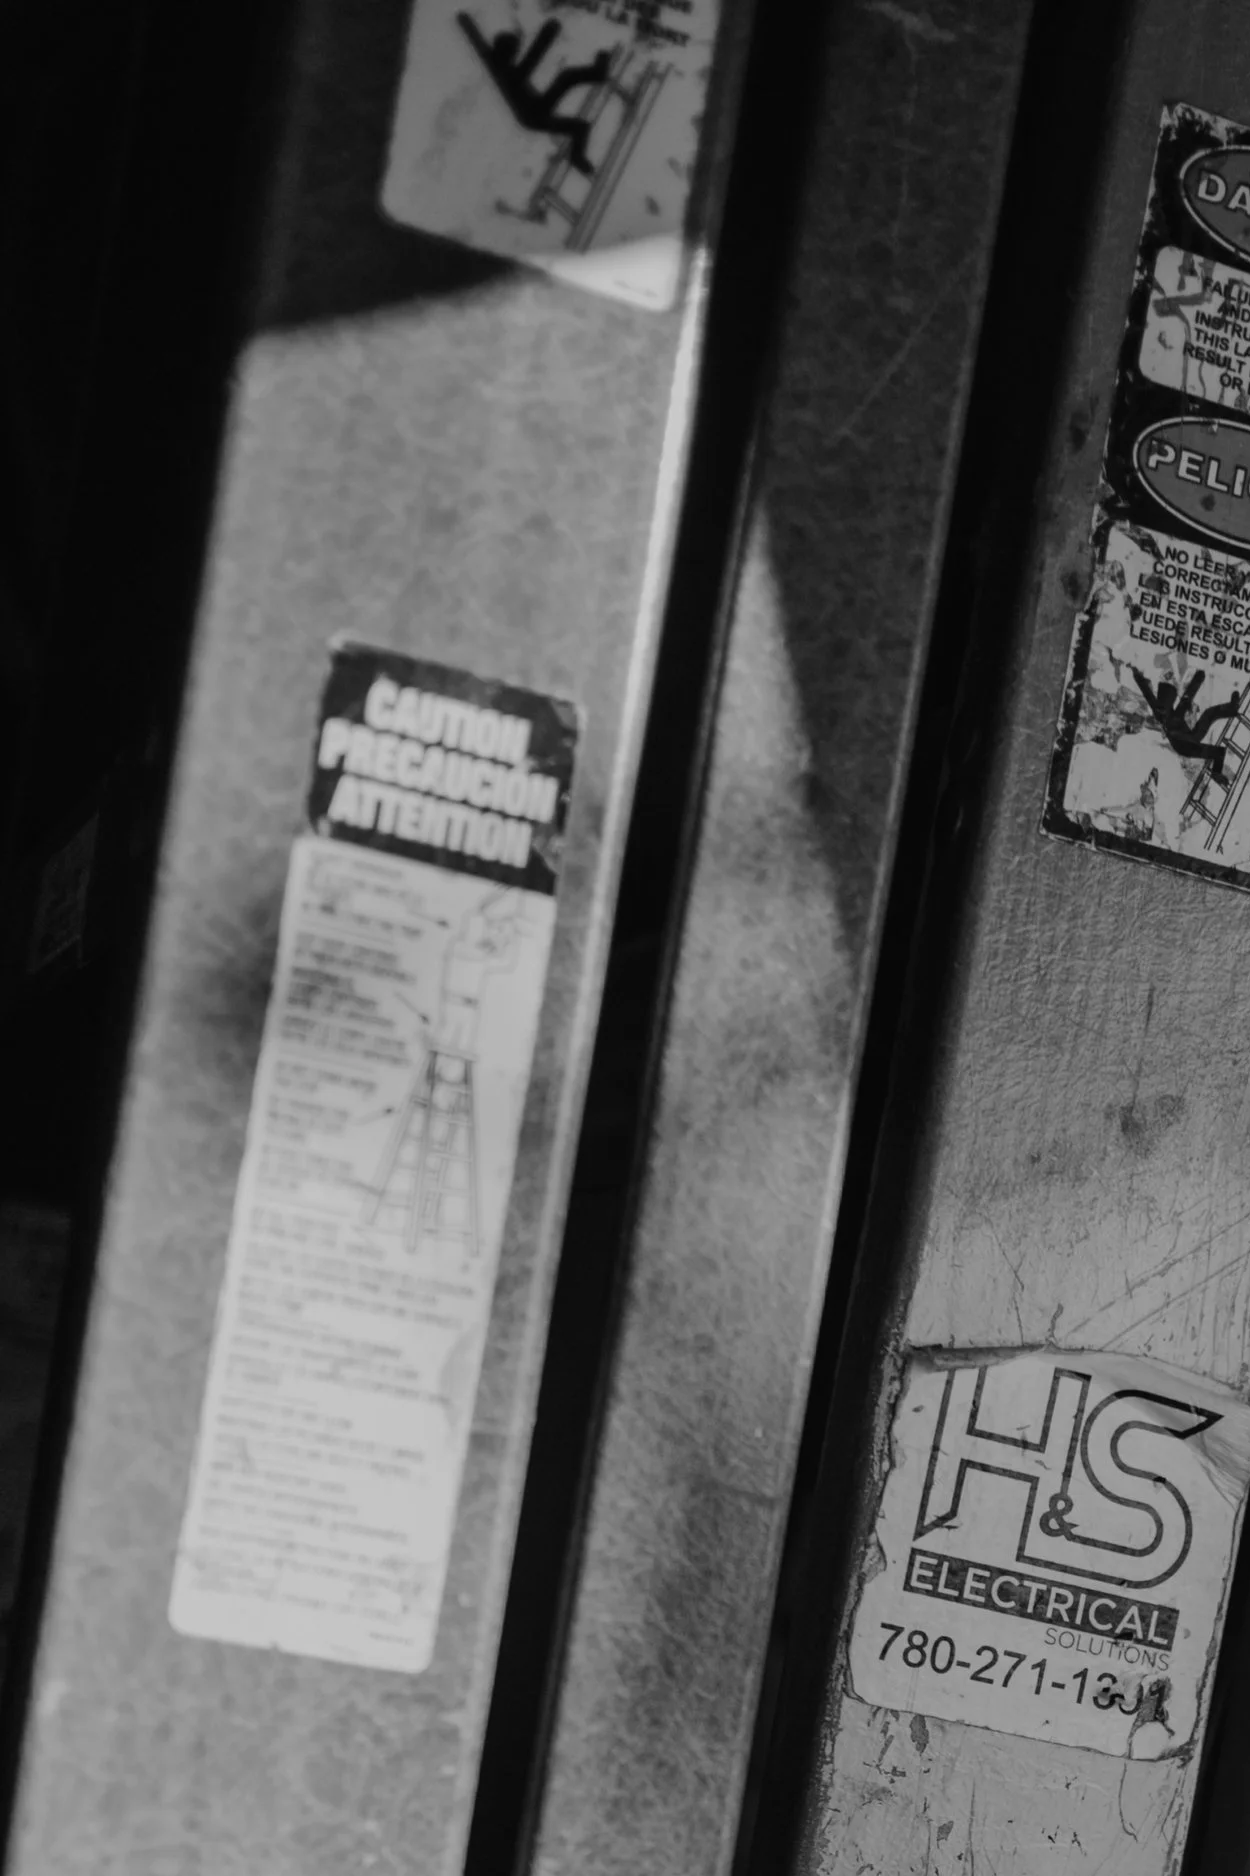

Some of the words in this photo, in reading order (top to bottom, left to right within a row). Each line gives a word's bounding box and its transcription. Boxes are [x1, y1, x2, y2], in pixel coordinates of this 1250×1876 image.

[1182, 341, 1245, 375] RESULT
[1194, 328, 1230, 352] THIS
[1219, 372, 1243, 392] OR
[1164, 545, 1189, 566] NO
[1192, 554, 1238, 581] LEER
[1139, 591, 1162, 611] EN
[1165, 599, 1208, 625] ESTA
[1128, 623, 1210, 661] LESIONES
[362, 676, 531, 765] CAUTION
[326, 771, 534, 869] ATTENTION
[913, 1366, 1224, 1589] H&S
[909, 1556, 1170, 1647] ELECTRICAL
[1044, 1627, 1170, 1672] SOLUTIONS
